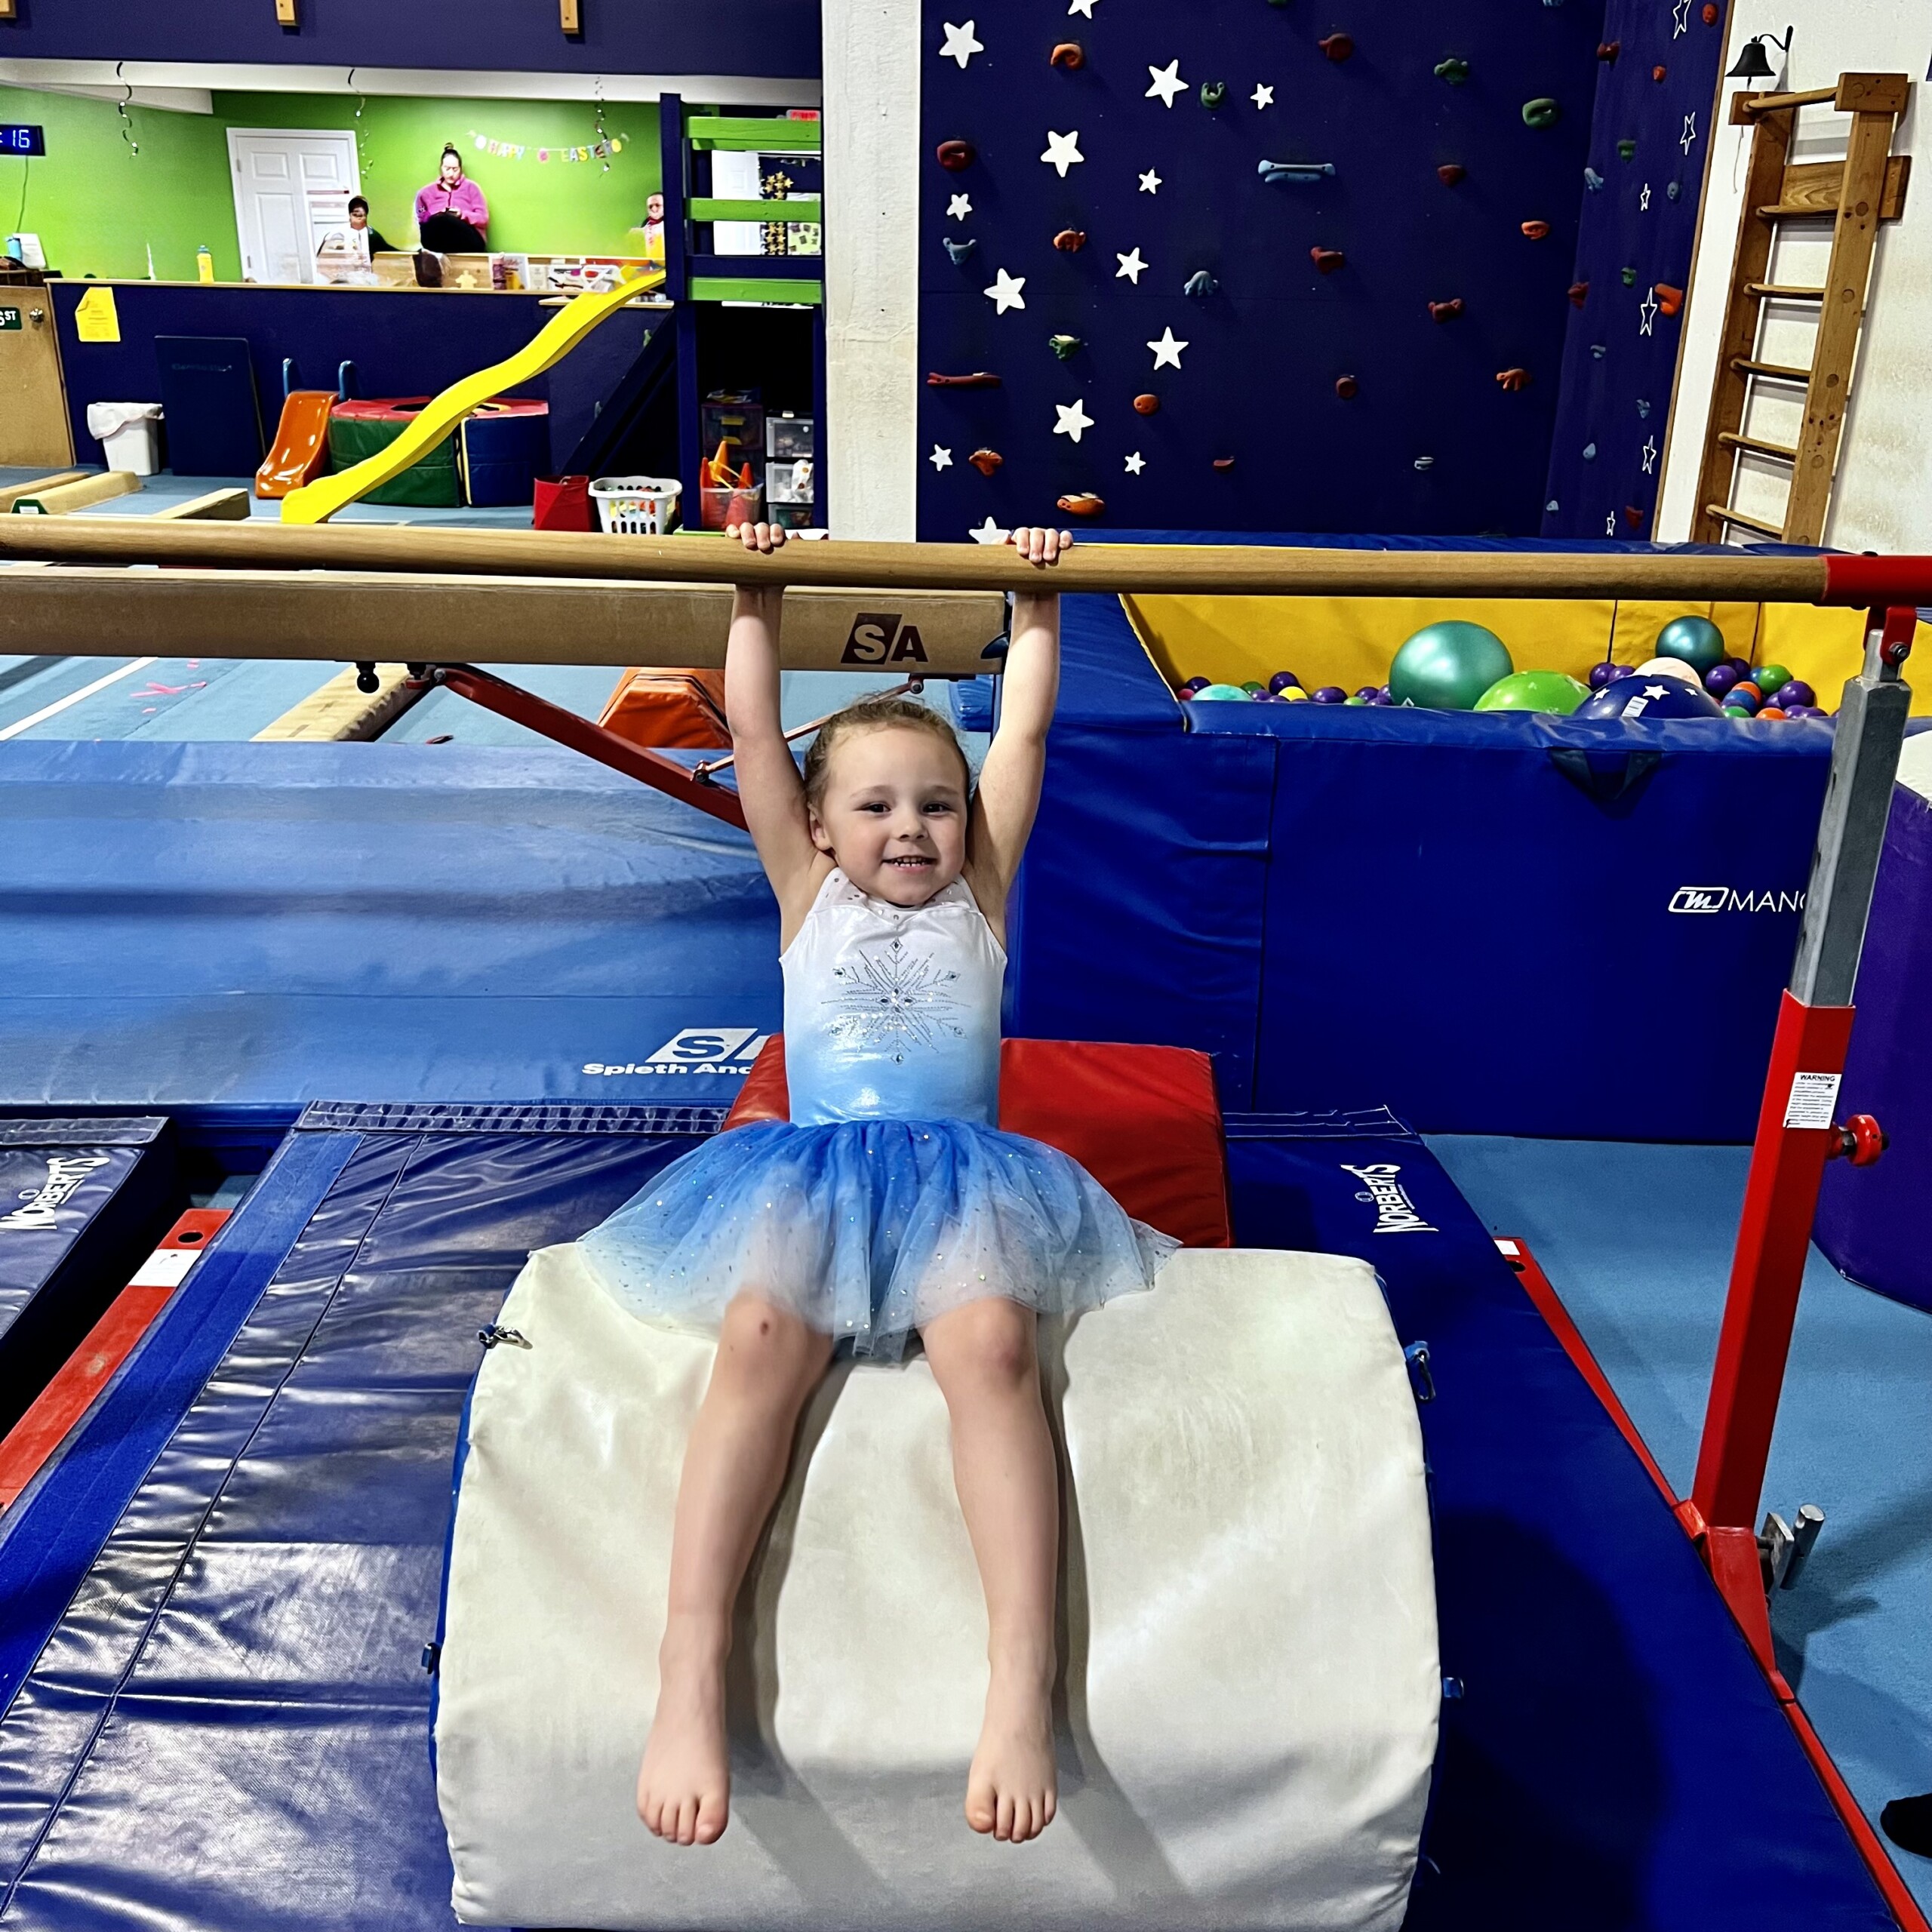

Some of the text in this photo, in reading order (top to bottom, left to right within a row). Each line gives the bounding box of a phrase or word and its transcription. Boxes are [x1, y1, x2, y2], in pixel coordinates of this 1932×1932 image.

[853, 623, 929, 663] SA
[582, 1063, 688, 1076] Spieth
[0, 1157, 110, 1230] NORBERTS
[1339, 1164, 1439, 1232] NORBERTS
